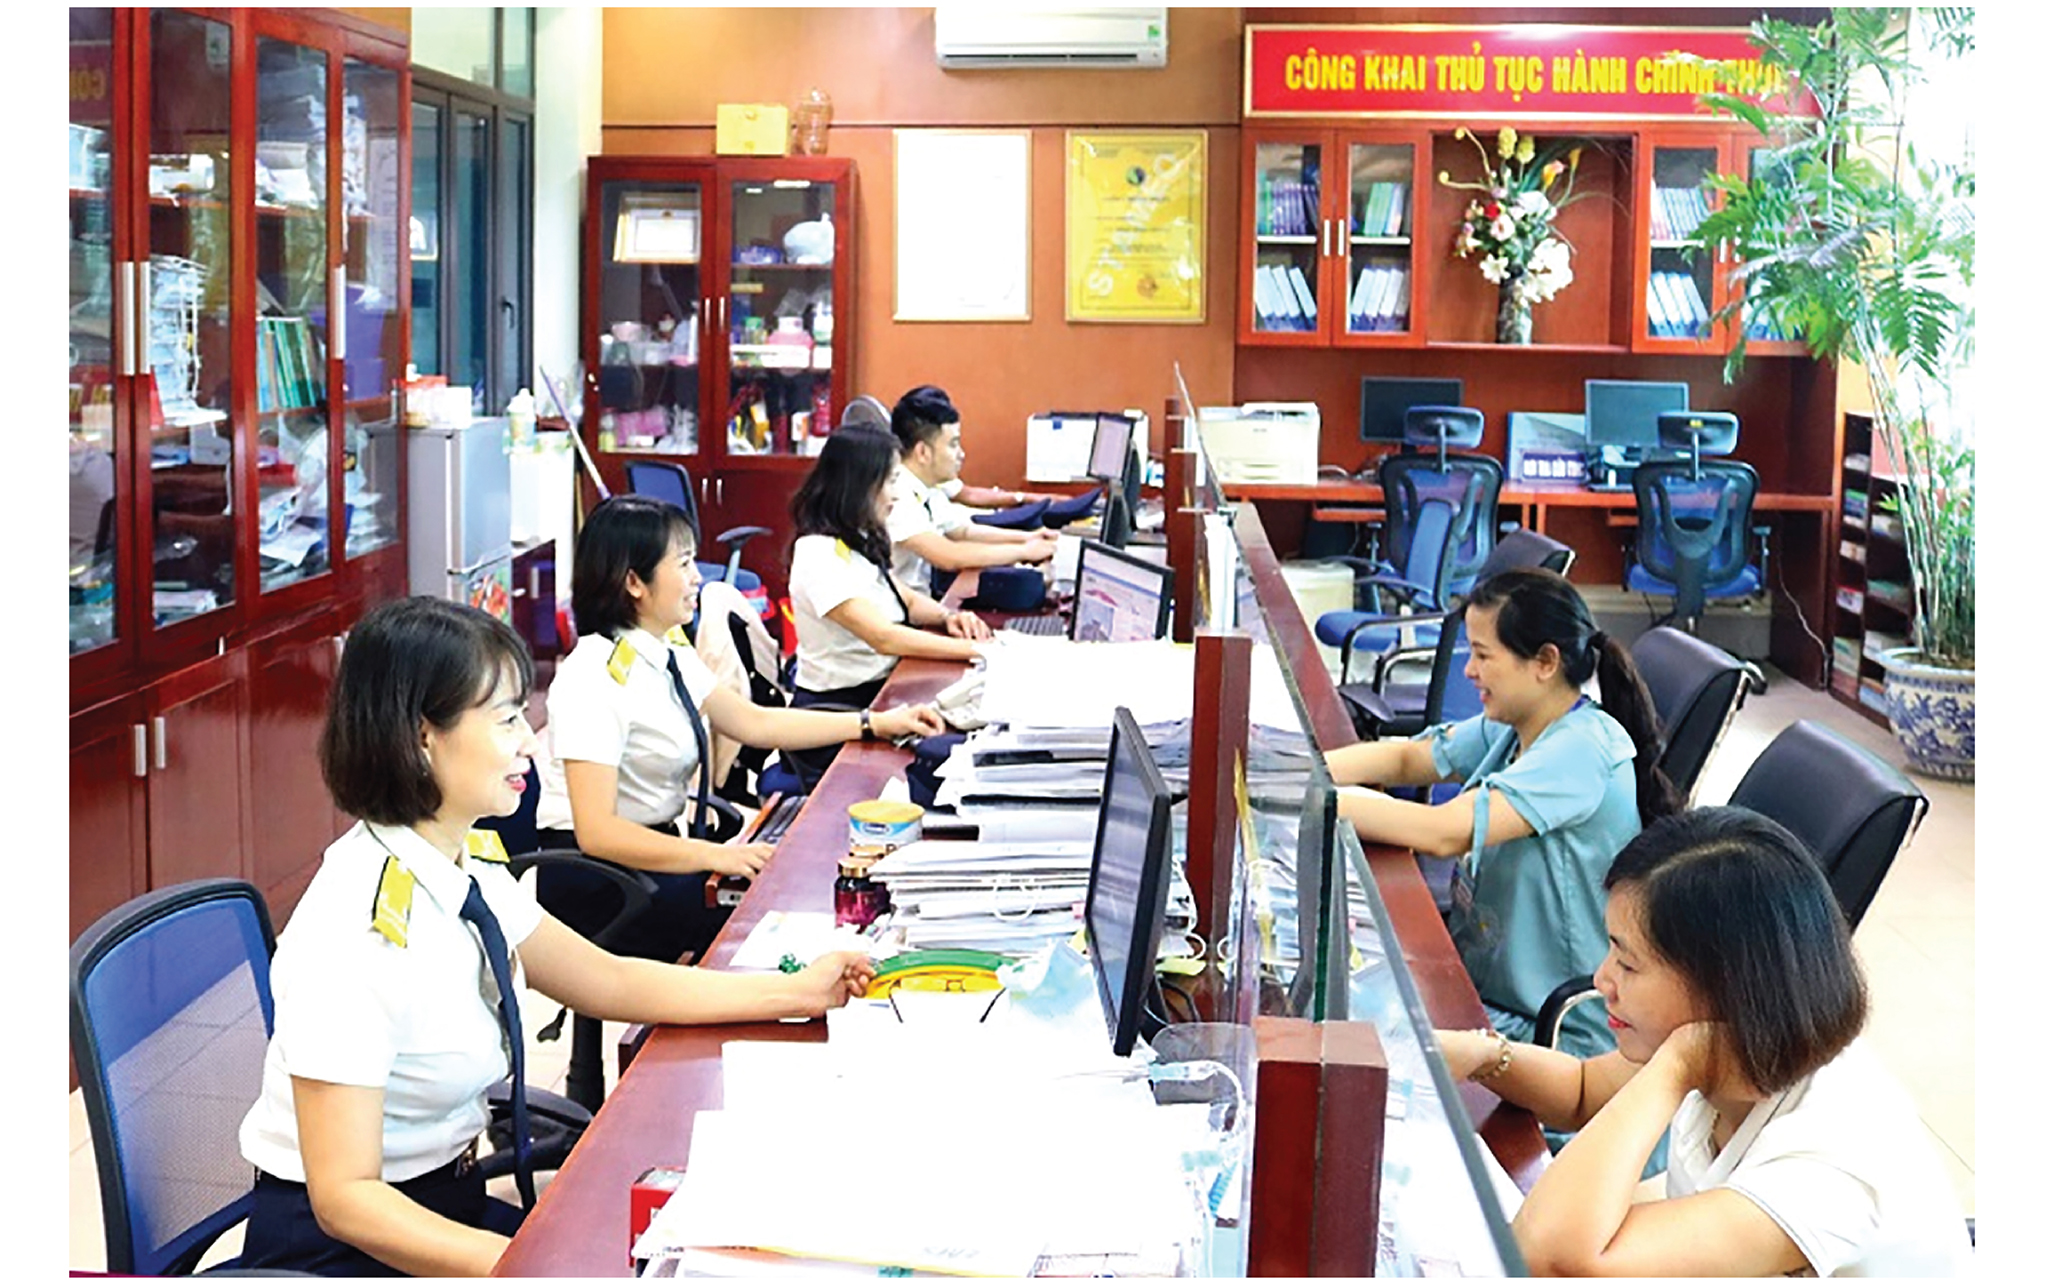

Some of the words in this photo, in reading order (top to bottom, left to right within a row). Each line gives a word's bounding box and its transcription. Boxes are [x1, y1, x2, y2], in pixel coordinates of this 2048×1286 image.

[1285, 47, 1356, 90] CÔNG
[1364, 55, 1426, 91] KHAI
[1435, 41, 1485, 91] THỦ
[1493, 56, 1544, 102] TỤC
[1552, 48, 1627, 93] HÀNH
